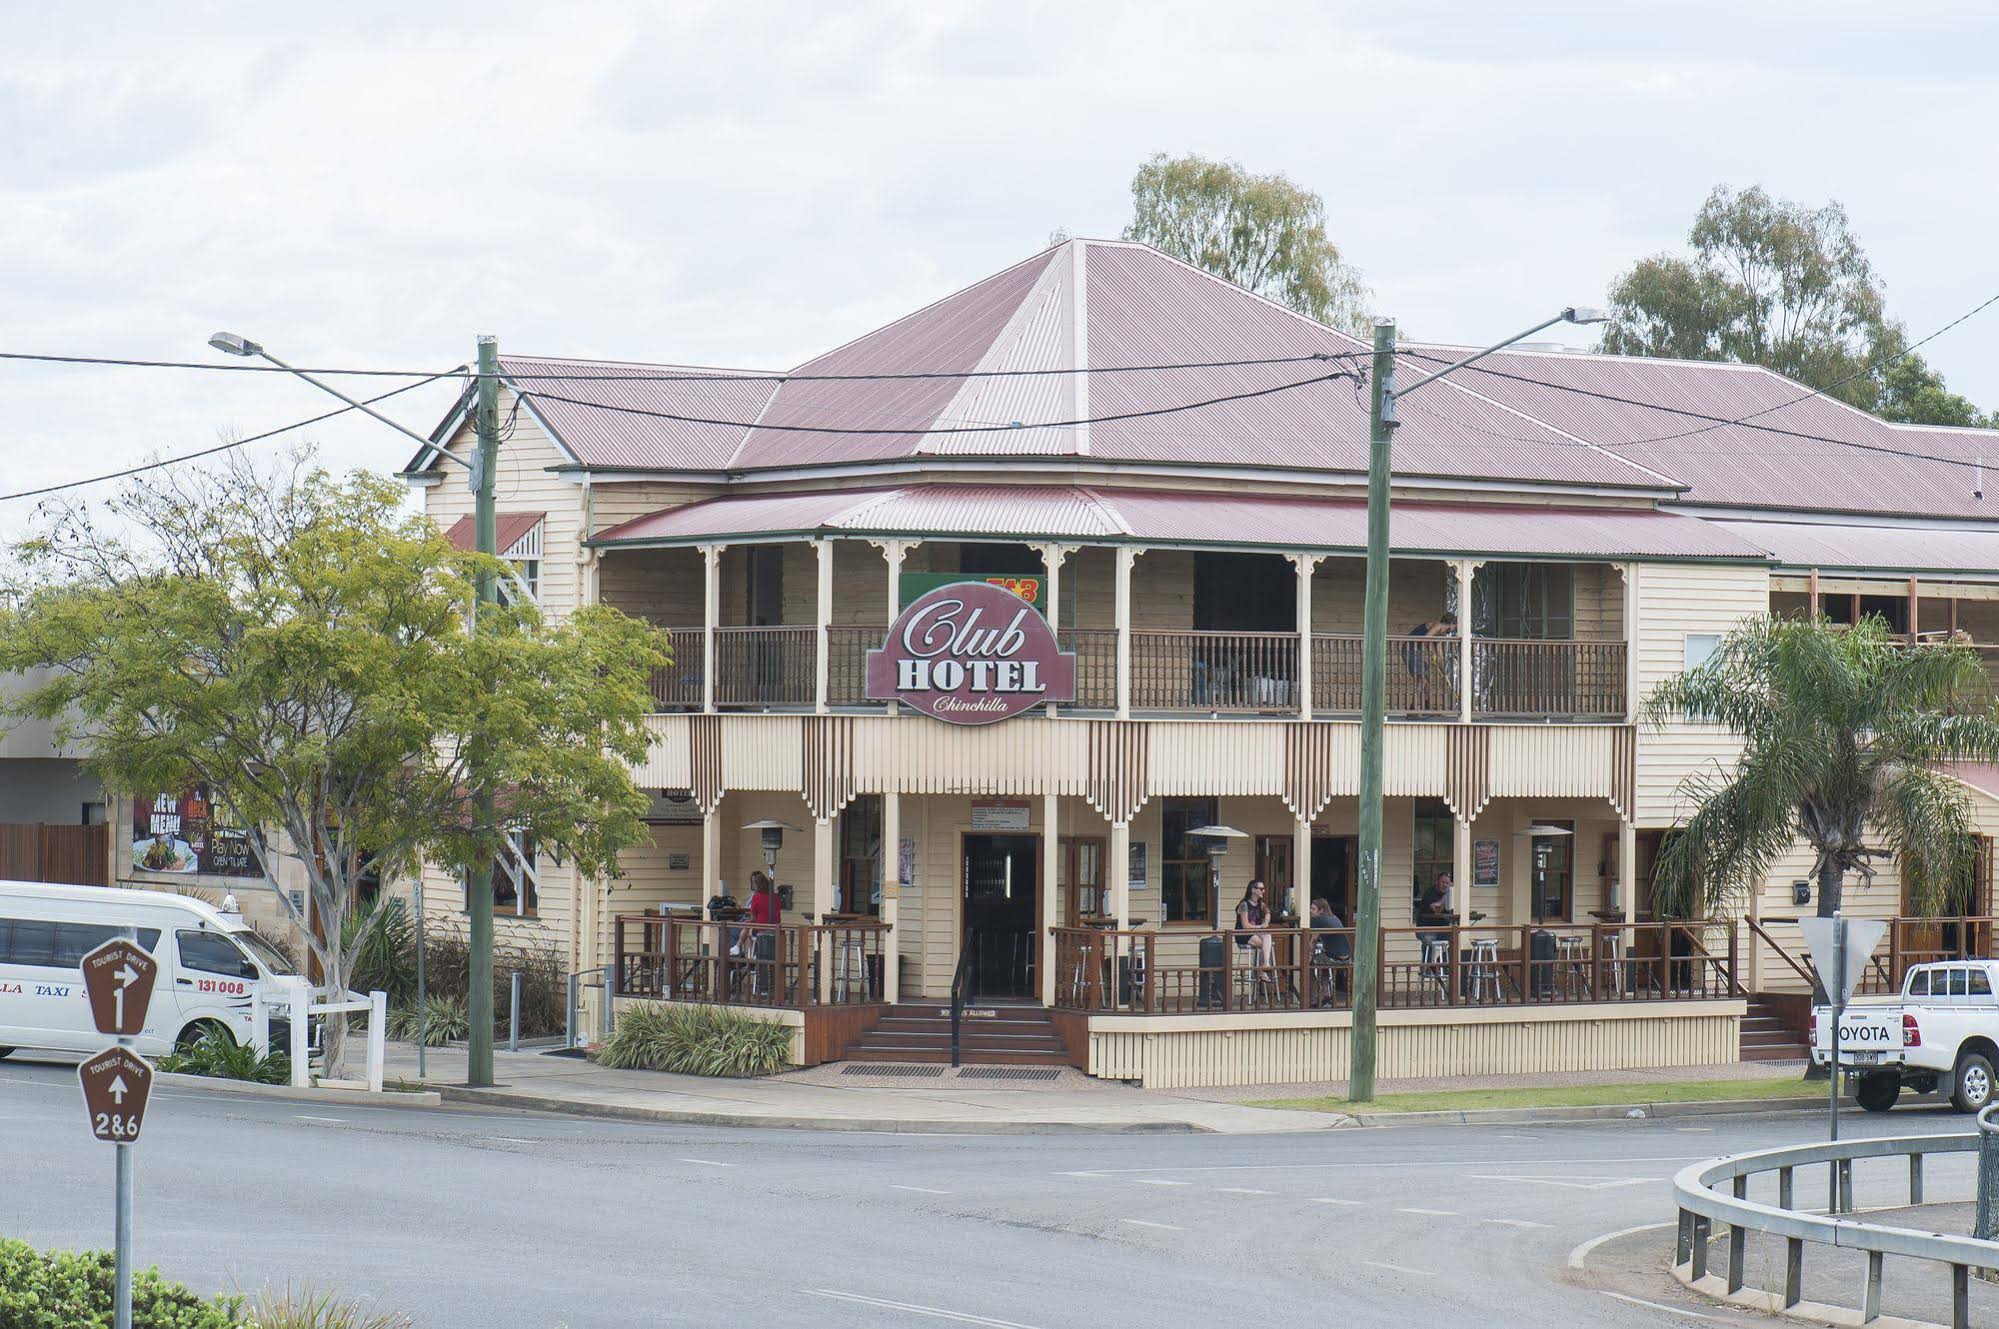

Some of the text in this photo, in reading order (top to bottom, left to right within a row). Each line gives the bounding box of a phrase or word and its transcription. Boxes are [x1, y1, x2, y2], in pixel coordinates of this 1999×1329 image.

[903, 599, 1028, 658] Club
[897, 660, 1047, 692] HOTEL
[933, 695, 1008, 712] Chinchilla
[153, 792, 177, 813] NEW
[150, 814, 181, 835] MENU
[212, 838, 250, 857] Play Now
[213, 856, 228, 866] OPEN
[92, 950, 149, 970] TOURIST DRIVE
[35, 985, 70, 996] TAXI
[198, 979, 244, 994] 131 008
[113, 987, 123, 1031] 1
[1831, 1026, 1890, 1041] OYOTA
[90, 1056, 145, 1077] TOURIST DRIVE
[95, 1112, 138, 1135] 2&6
